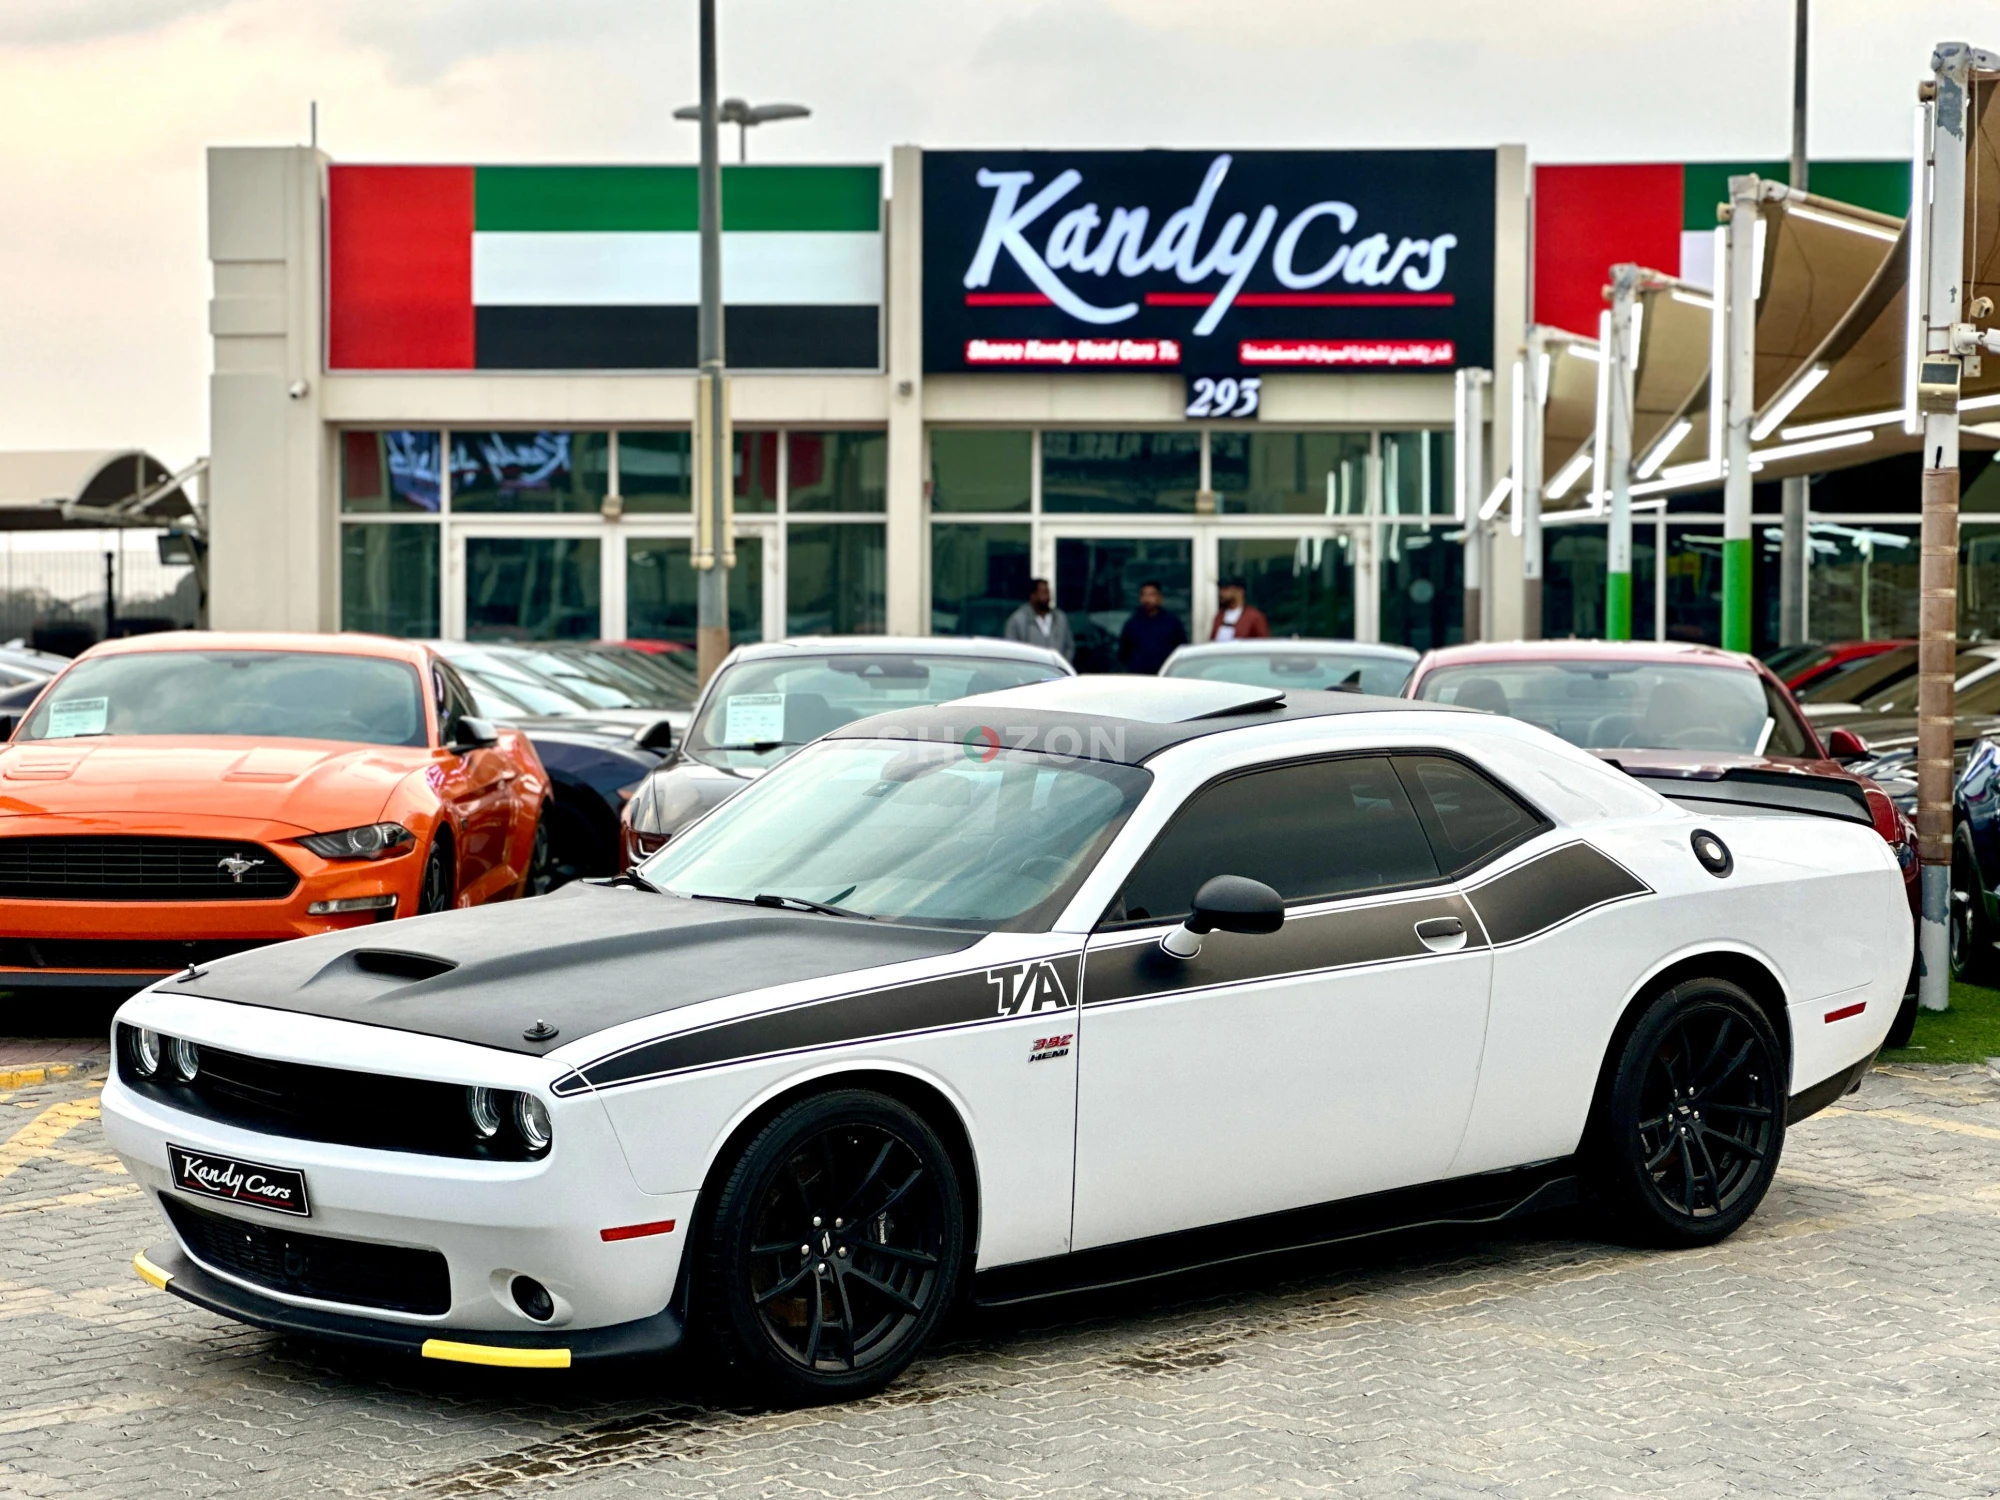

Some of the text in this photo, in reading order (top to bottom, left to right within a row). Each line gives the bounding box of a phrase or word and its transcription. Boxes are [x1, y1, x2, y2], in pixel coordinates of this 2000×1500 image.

[964, 154, 1457, 335] Kandy Cars
[1186, 377, 1262, 417] 293
[1028, 1048, 1069, 1062] HEMI
[1031, 1034, 1074, 1052] 392
[181, 1154, 292, 1199] Kandy Cars
